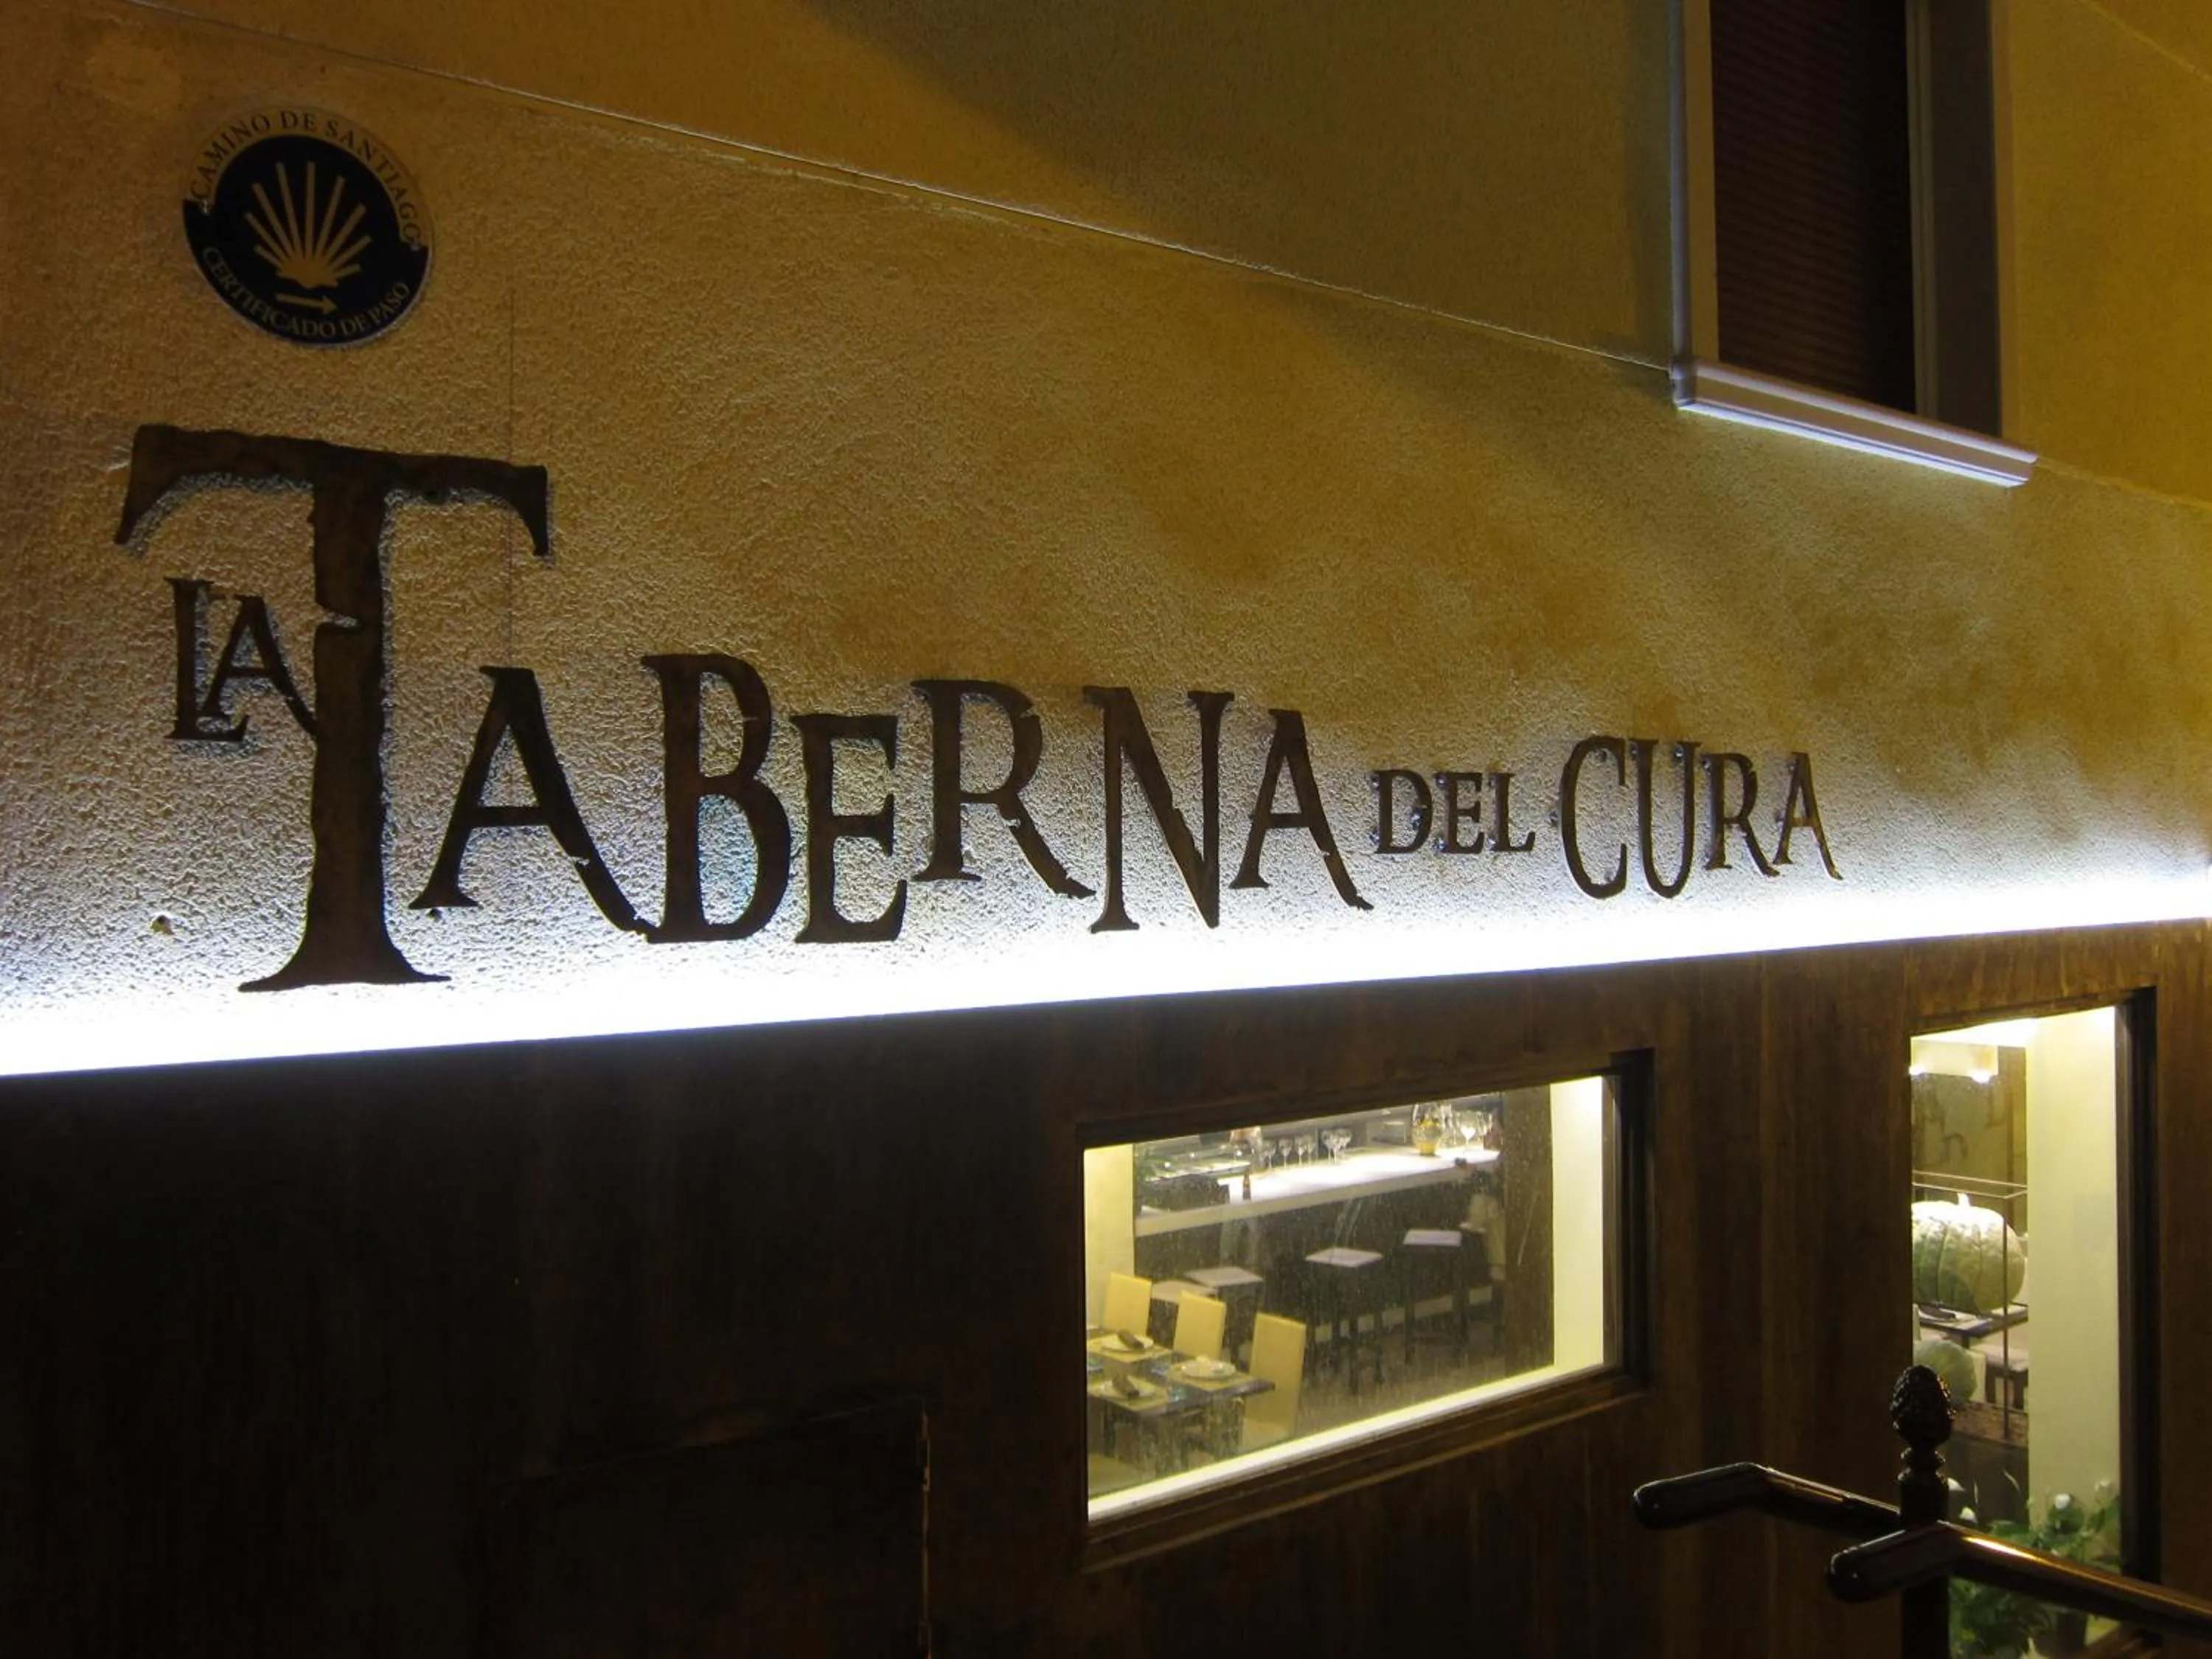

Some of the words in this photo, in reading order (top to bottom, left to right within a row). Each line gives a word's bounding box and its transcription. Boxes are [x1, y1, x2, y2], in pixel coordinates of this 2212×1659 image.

[189, 114, 271, 200] CAMINO
[280, 110, 316, 131] DE
[324, 119, 422, 242] SANTIAGO
[201, 245, 336, 338] CERTIFICADO
[340, 313, 371, 336] DE
[368, 281, 411, 326] PASO
[114, 425, 1373, 992] TABERNA
[164, 577, 319, 740] LA
[1372, 768, 1535, 855] DEL
[1559, 735, 1844, 900] CURA
